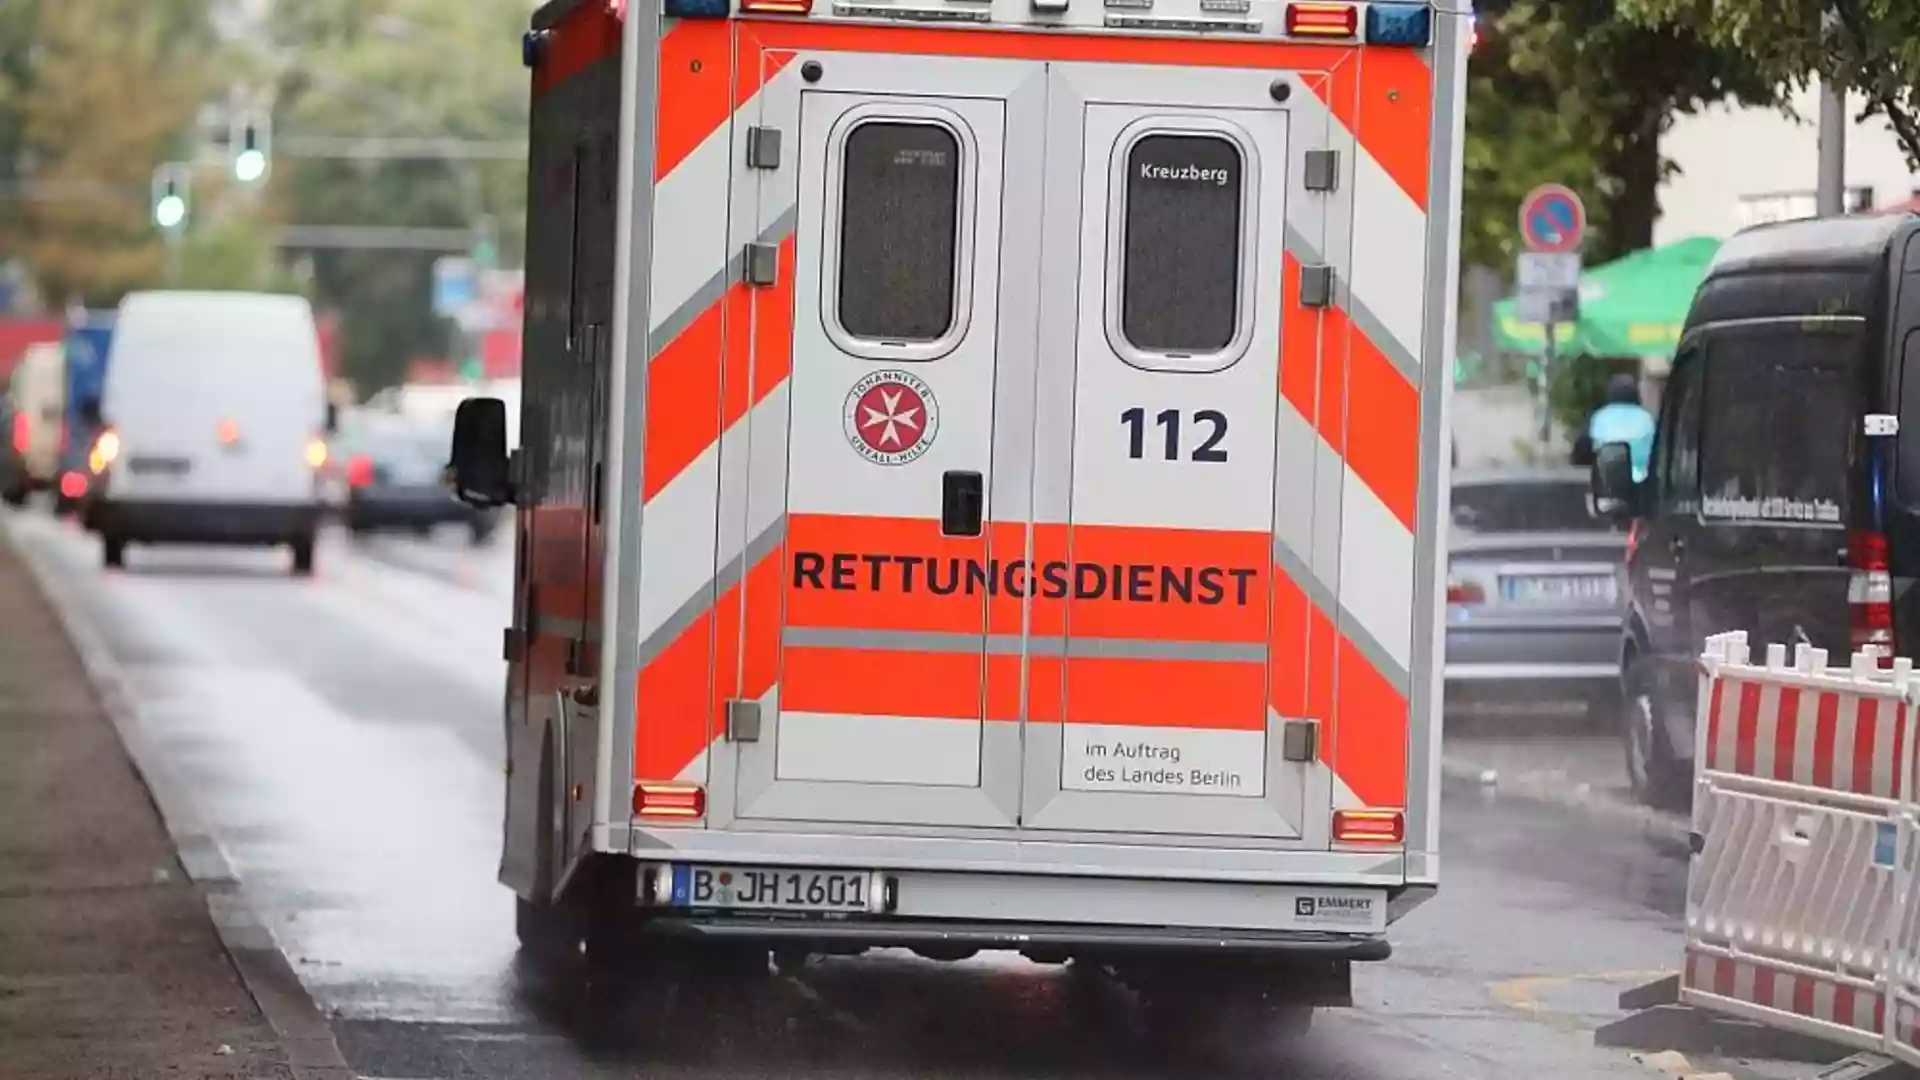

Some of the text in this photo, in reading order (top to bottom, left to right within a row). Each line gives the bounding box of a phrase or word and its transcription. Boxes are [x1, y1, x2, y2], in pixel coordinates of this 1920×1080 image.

[1141, 163, 1229, 186] Kreuzberg
[1121, 407, 1228, 463] 112
[793, 551, 1258, 606] RETTUNGSDIENST
[1085, 741, 1181, 763] im Auftrag
[1084, 766, 1241, 788] des Landes Berlin
[694, 869, 714, 901] B
